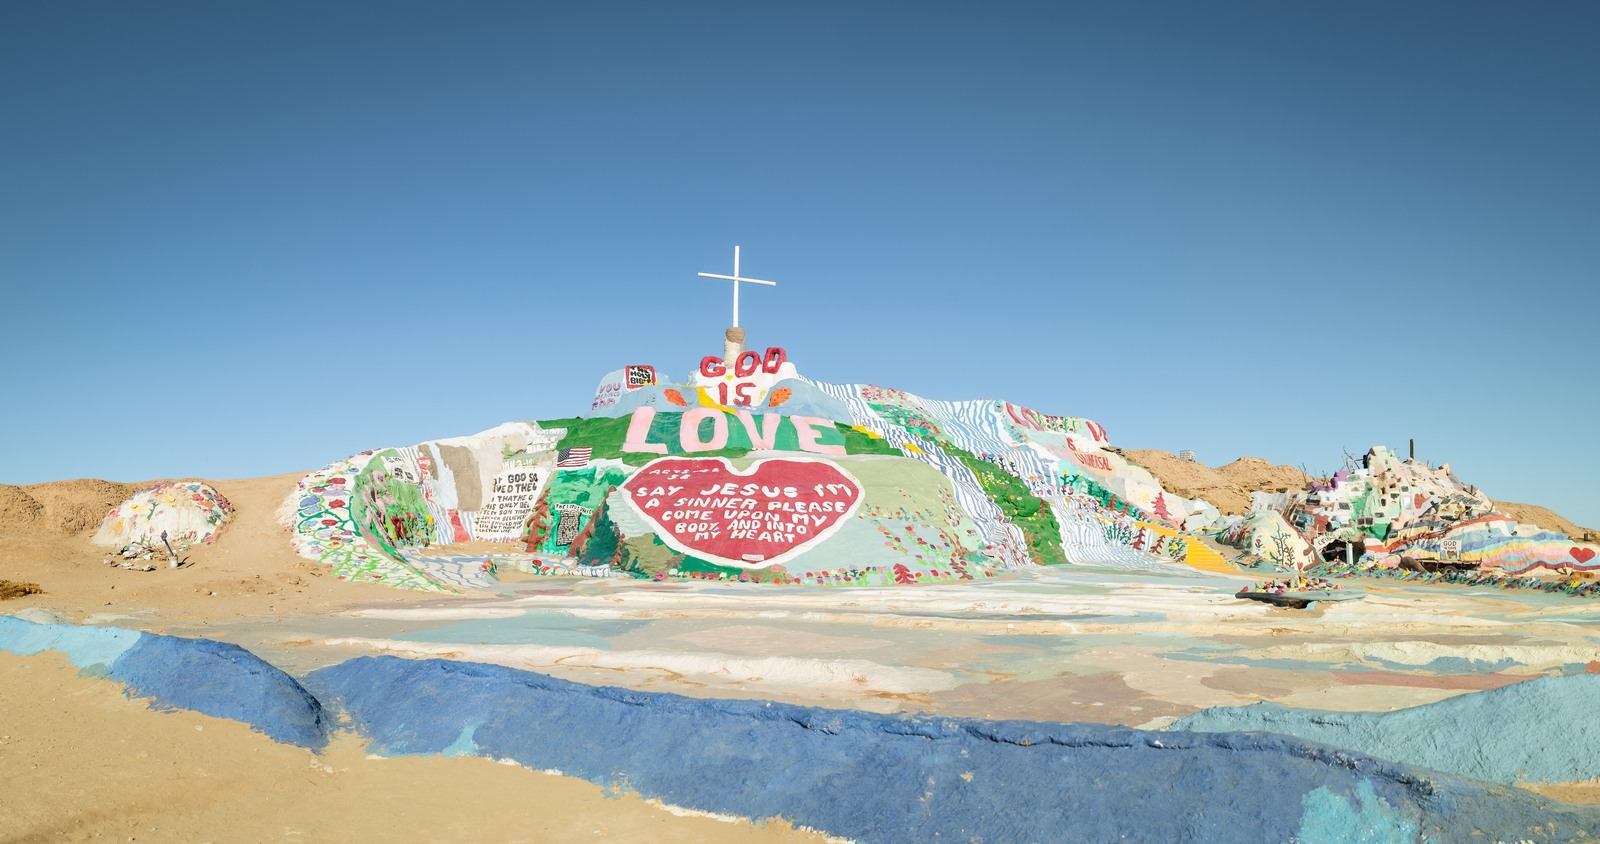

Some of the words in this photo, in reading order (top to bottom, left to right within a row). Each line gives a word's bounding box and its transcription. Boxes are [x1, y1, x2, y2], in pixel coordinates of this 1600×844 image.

[700, 347, 787, 378] GOD
[630, 371, 650, 379] HOLY
[718, 382, 756, 406] IS
[620, 406, 847, 455] LOVE
[508, 473, 526, 484] GOD
[636, 486, 684, 496] SAY
[700, 483, 798, 498] JESUS
[645, 498, 660, 509] A
[673, 497, 758, 510] SINNER
[768, 501, 846, 513] PLEASE
[662, 510, 713, 521] COME
[723, 510, 780, 522] UPON
[791, 513, 827, 527] MY
[727, 519, 761, 531] AND
[767, 521, 807, 534] INTO
[694, 531, 721, 541] MY
[730, 529, 795, 543] HEART
